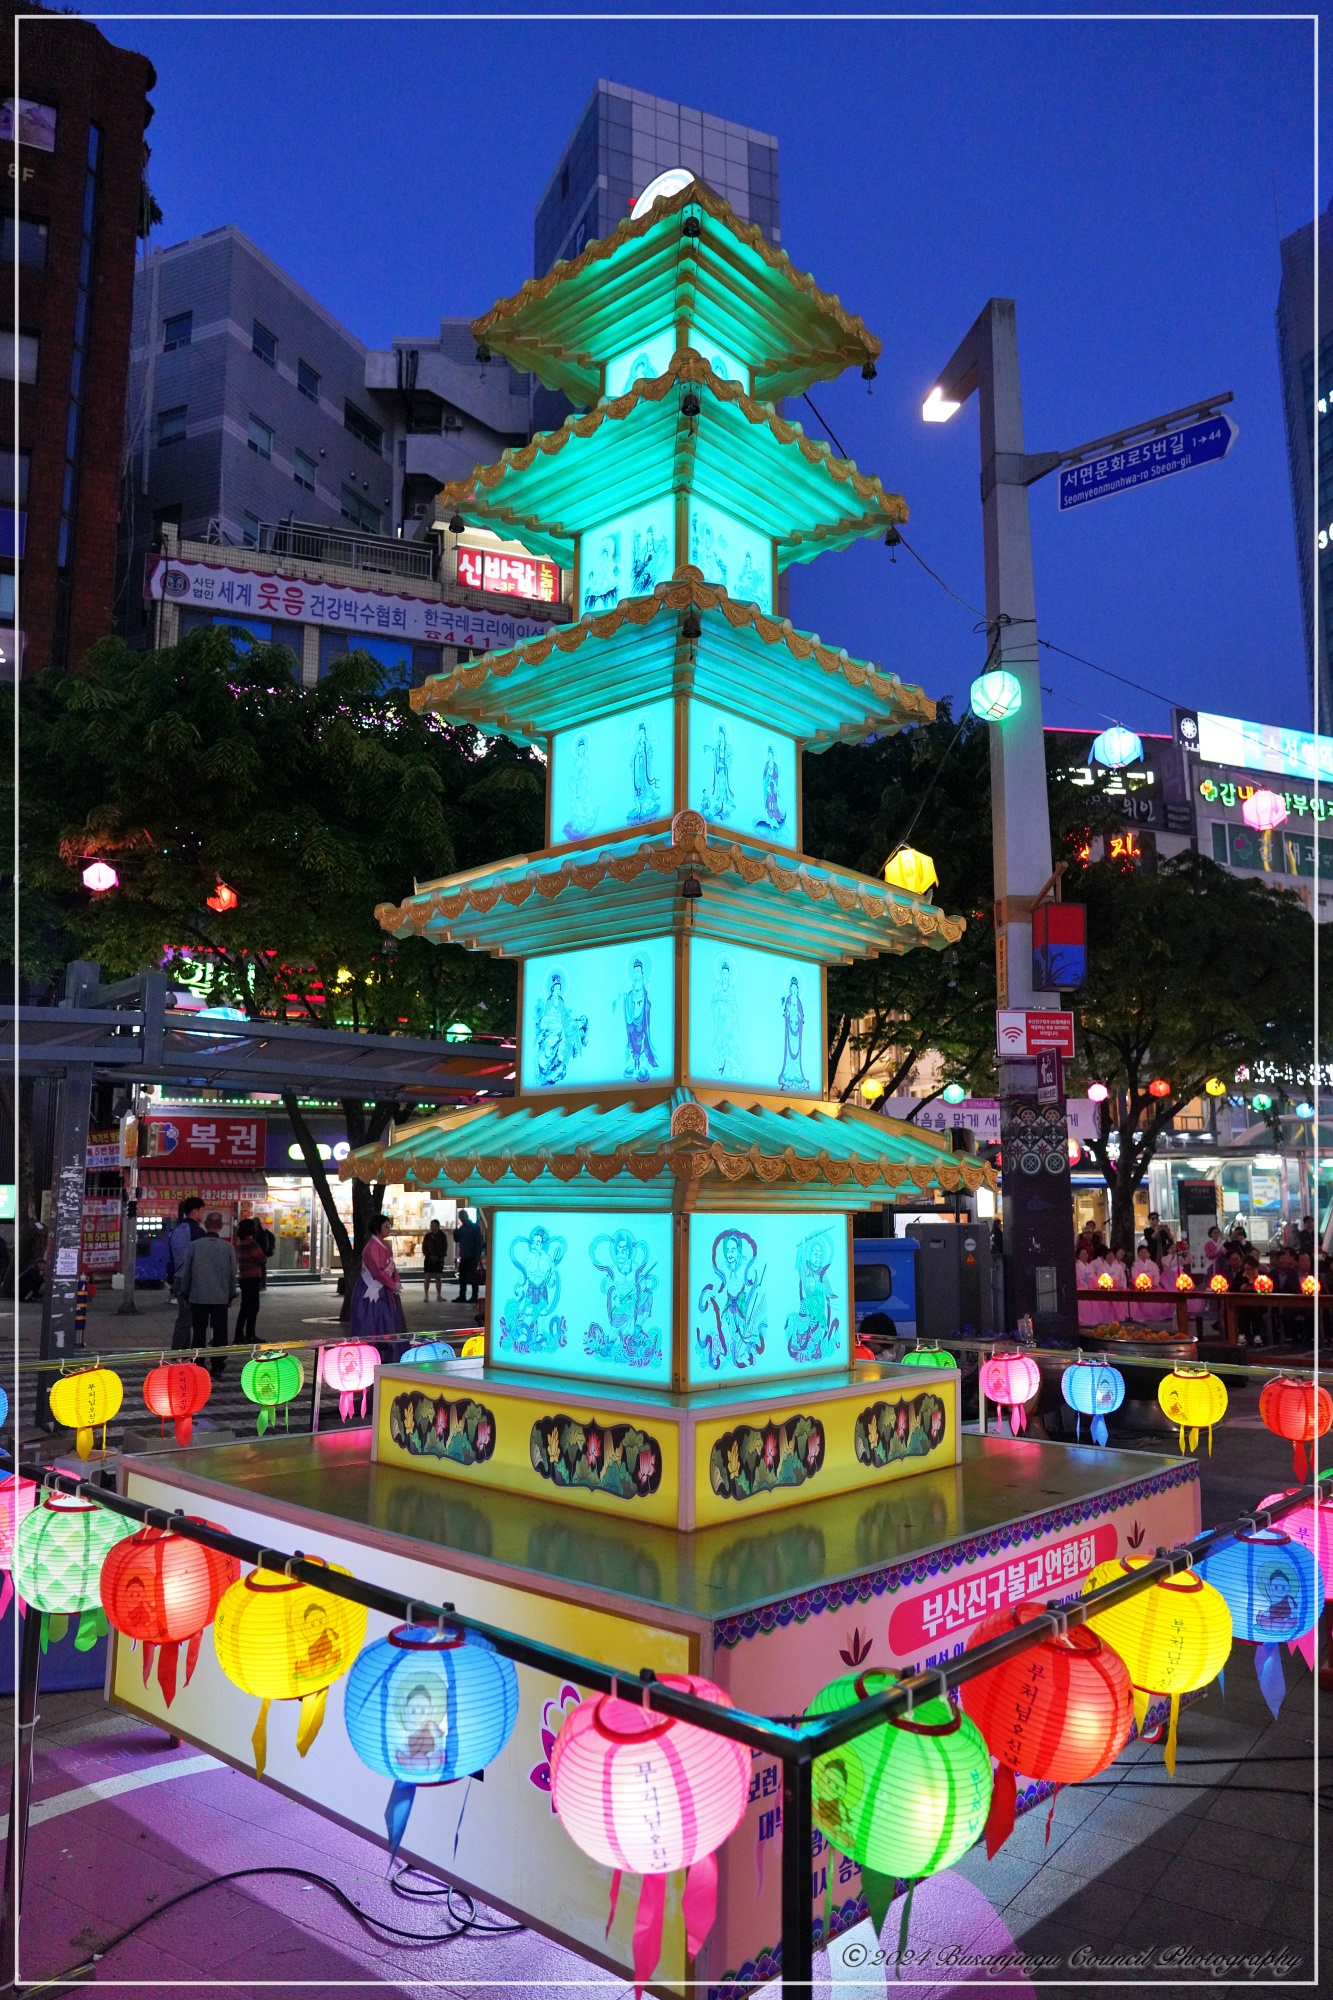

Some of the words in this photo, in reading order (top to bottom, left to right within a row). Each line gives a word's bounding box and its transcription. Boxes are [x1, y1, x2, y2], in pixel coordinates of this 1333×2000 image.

[1064, 433, 1185, 487] 서면문화로5번길
[1063, 470, 1149, 506] Seomyeonmunhwa-ro
[1150, 454, 1192, 477] 5beon-gil
[193, 577, 215, 589] 사단
[459, 553, 536, 594] 신바람
[500, 582, 516, 592] 3F
[540, 563, 554, 602] 노래방
[193, 588, 214, 601] 법인
[217, 580, 252, 608] 세계
[257, 583, 306, 616] 웃음
[310, 594, 407, 631] 건강박수협회
[1046, 1072, 1053, 1083] 02
[953, 1112, 979, 1128] 맑게
[186, 1123, 257, 1156] 복권
[922, 1534, 1097, 1638] 부산진구불교연합회
